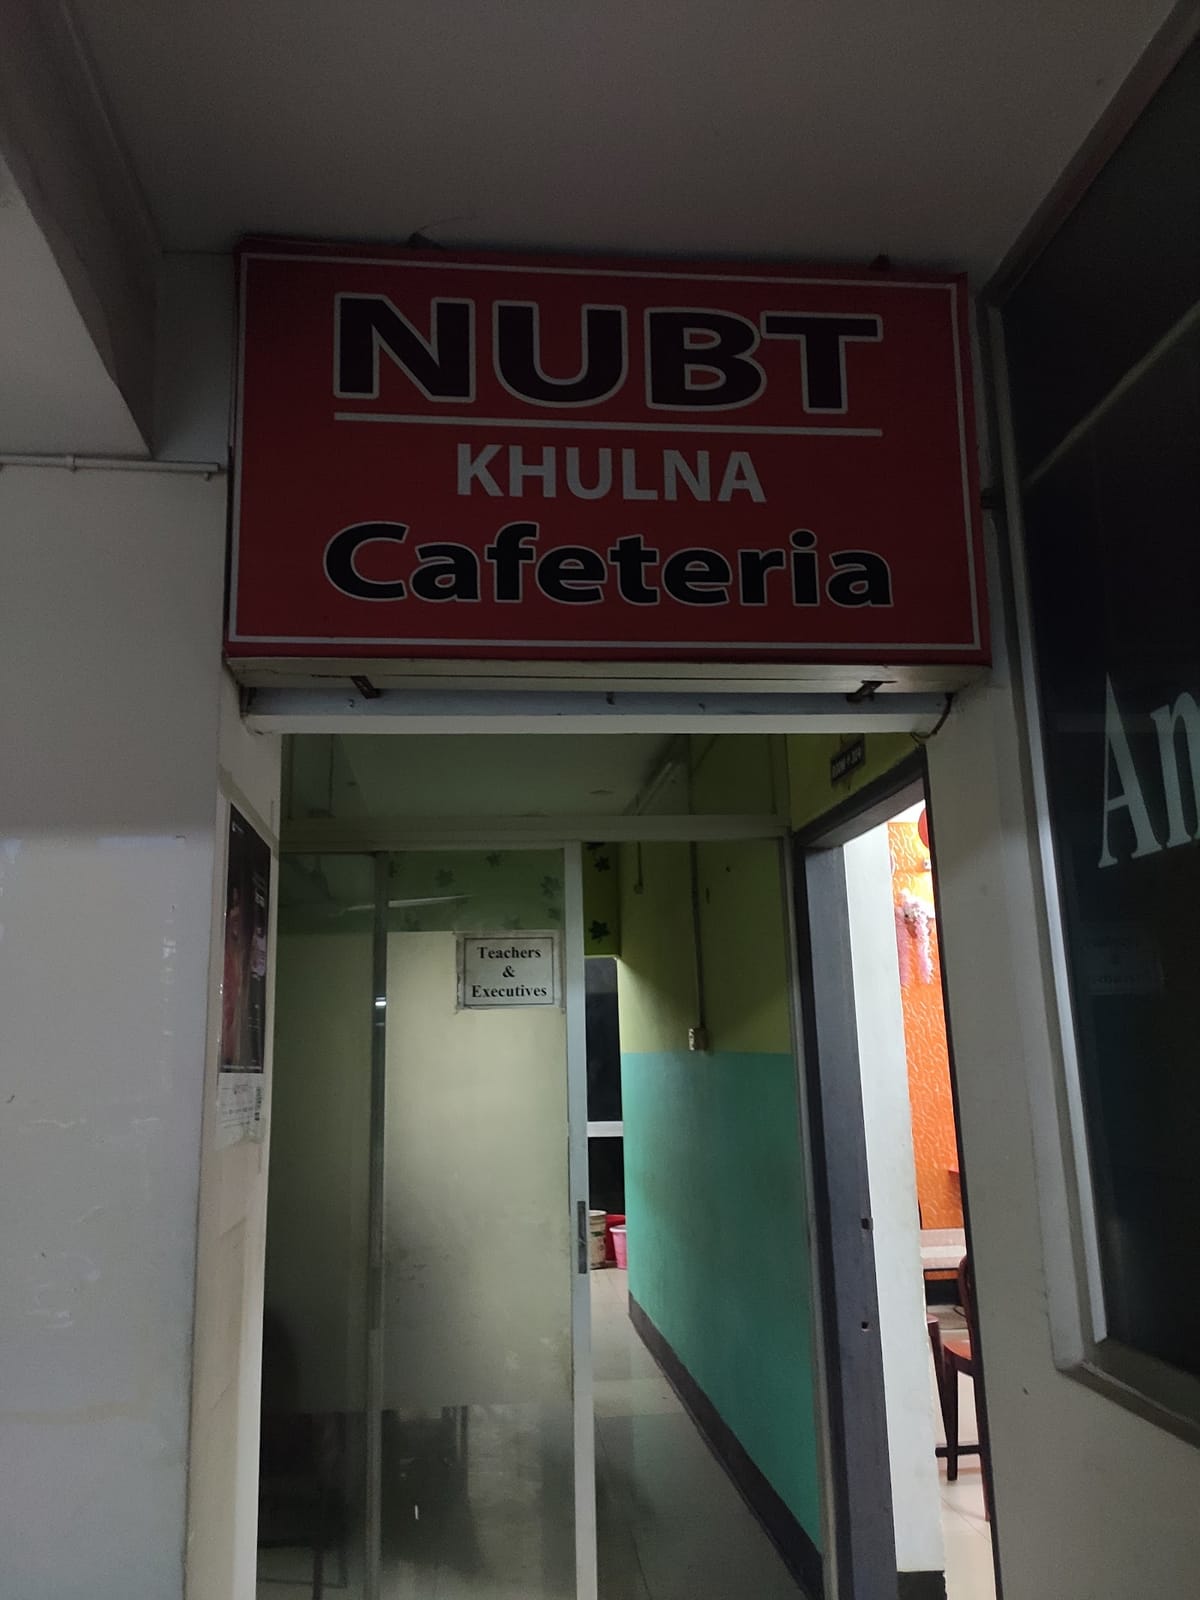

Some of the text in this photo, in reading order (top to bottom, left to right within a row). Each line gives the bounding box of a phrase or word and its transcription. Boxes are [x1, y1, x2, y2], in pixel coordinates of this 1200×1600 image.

[333, 291, 884, 415] NUBT
[456, 442, 767, 503] KHULNA
[322, 520, 895, 609] Cafeteria
[477, 946, 542, 959] Teachers
[502, 965, 516, 978] &
[471, 984, 548, 998] Executives
